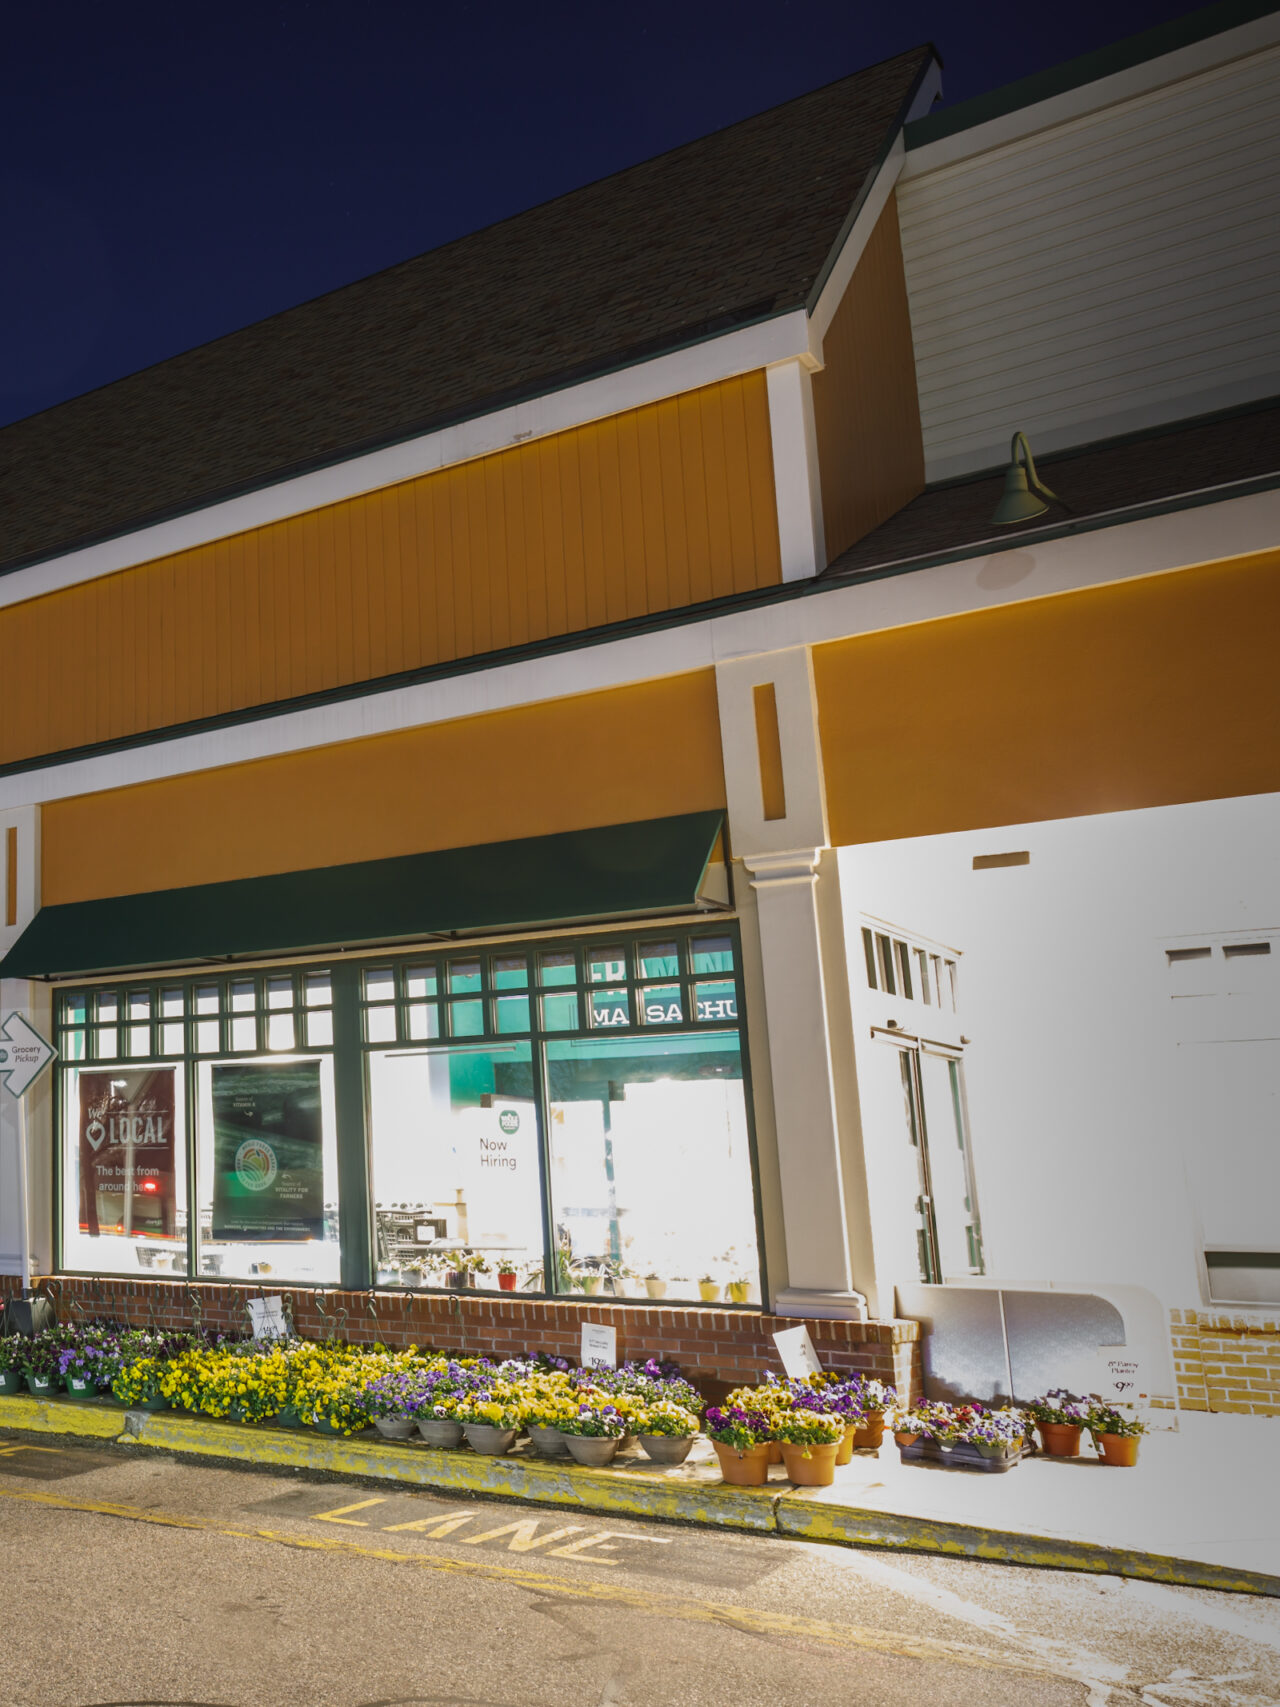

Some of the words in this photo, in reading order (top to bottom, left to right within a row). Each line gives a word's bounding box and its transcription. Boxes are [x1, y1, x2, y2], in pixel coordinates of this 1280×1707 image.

[12, 1046, 41, 1054] Grocery
[15, 1055, 39, 1063] Pickup
[110, 1117, 167, 1144] LOCAL
[480, 1138, 507, 1150] Now
[481, 1154, 517, 1171] Hiring
[96, 1165, 114, 1176] The
[137, 1165, 160, 1176] from
[309, 1498, 672, 1566] LANE
